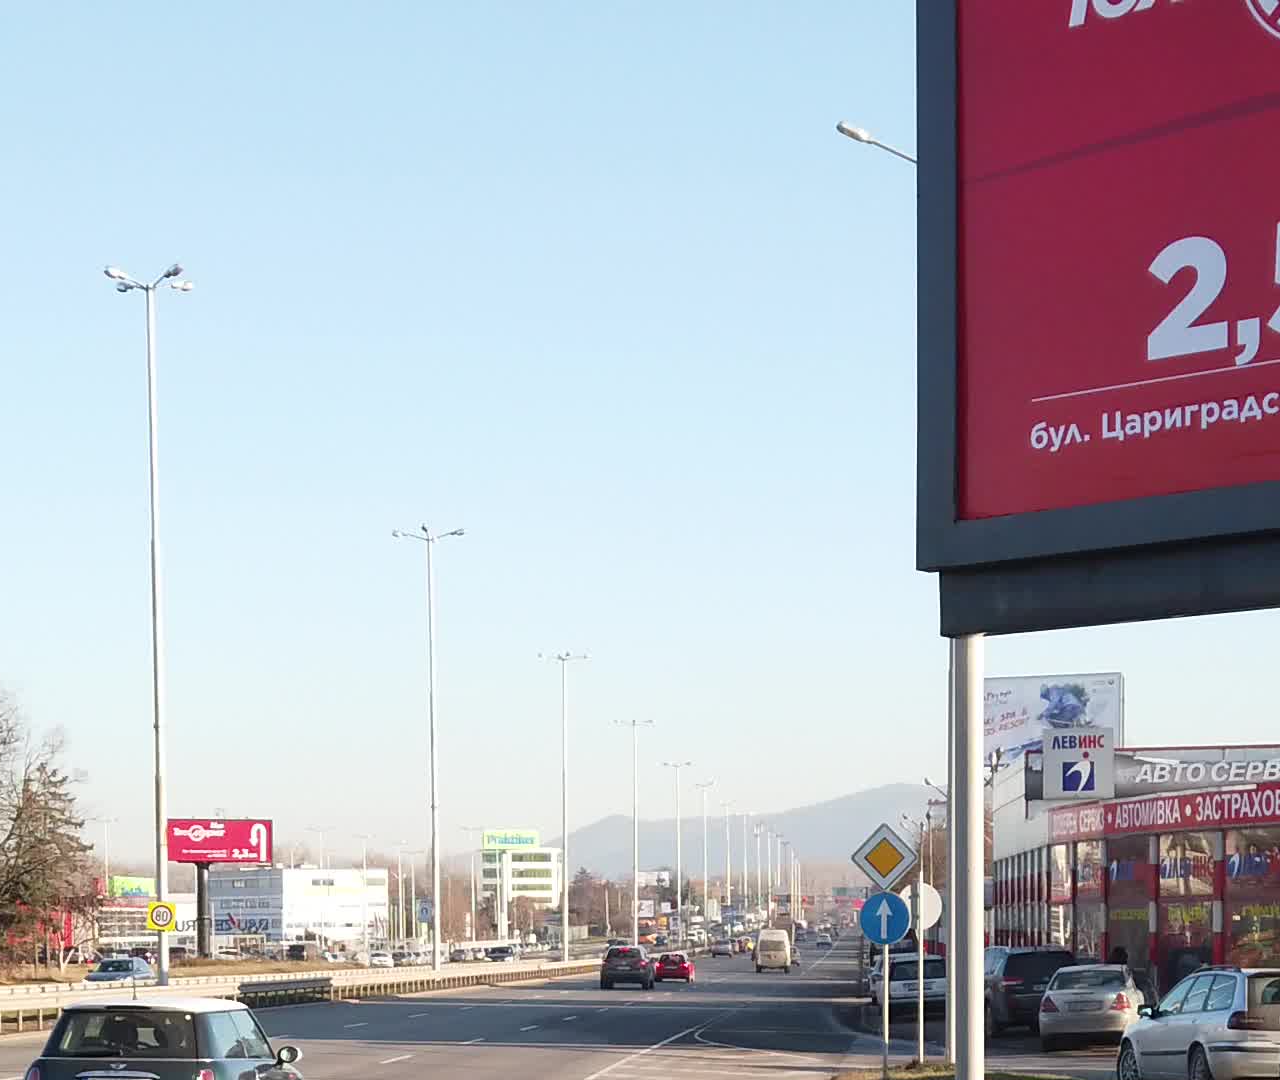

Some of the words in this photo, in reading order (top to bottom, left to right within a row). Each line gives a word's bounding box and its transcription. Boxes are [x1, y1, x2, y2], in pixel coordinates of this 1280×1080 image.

[1030, 420, 1090, 451] бул.
[1052, 734, 1105, 750] ЛЕВИНС
[1135, 763, 1206, 784] АВТО
[1115, 798, 1182, 828] АВТОМИВКА
[155, 910, 169, 922] 80
